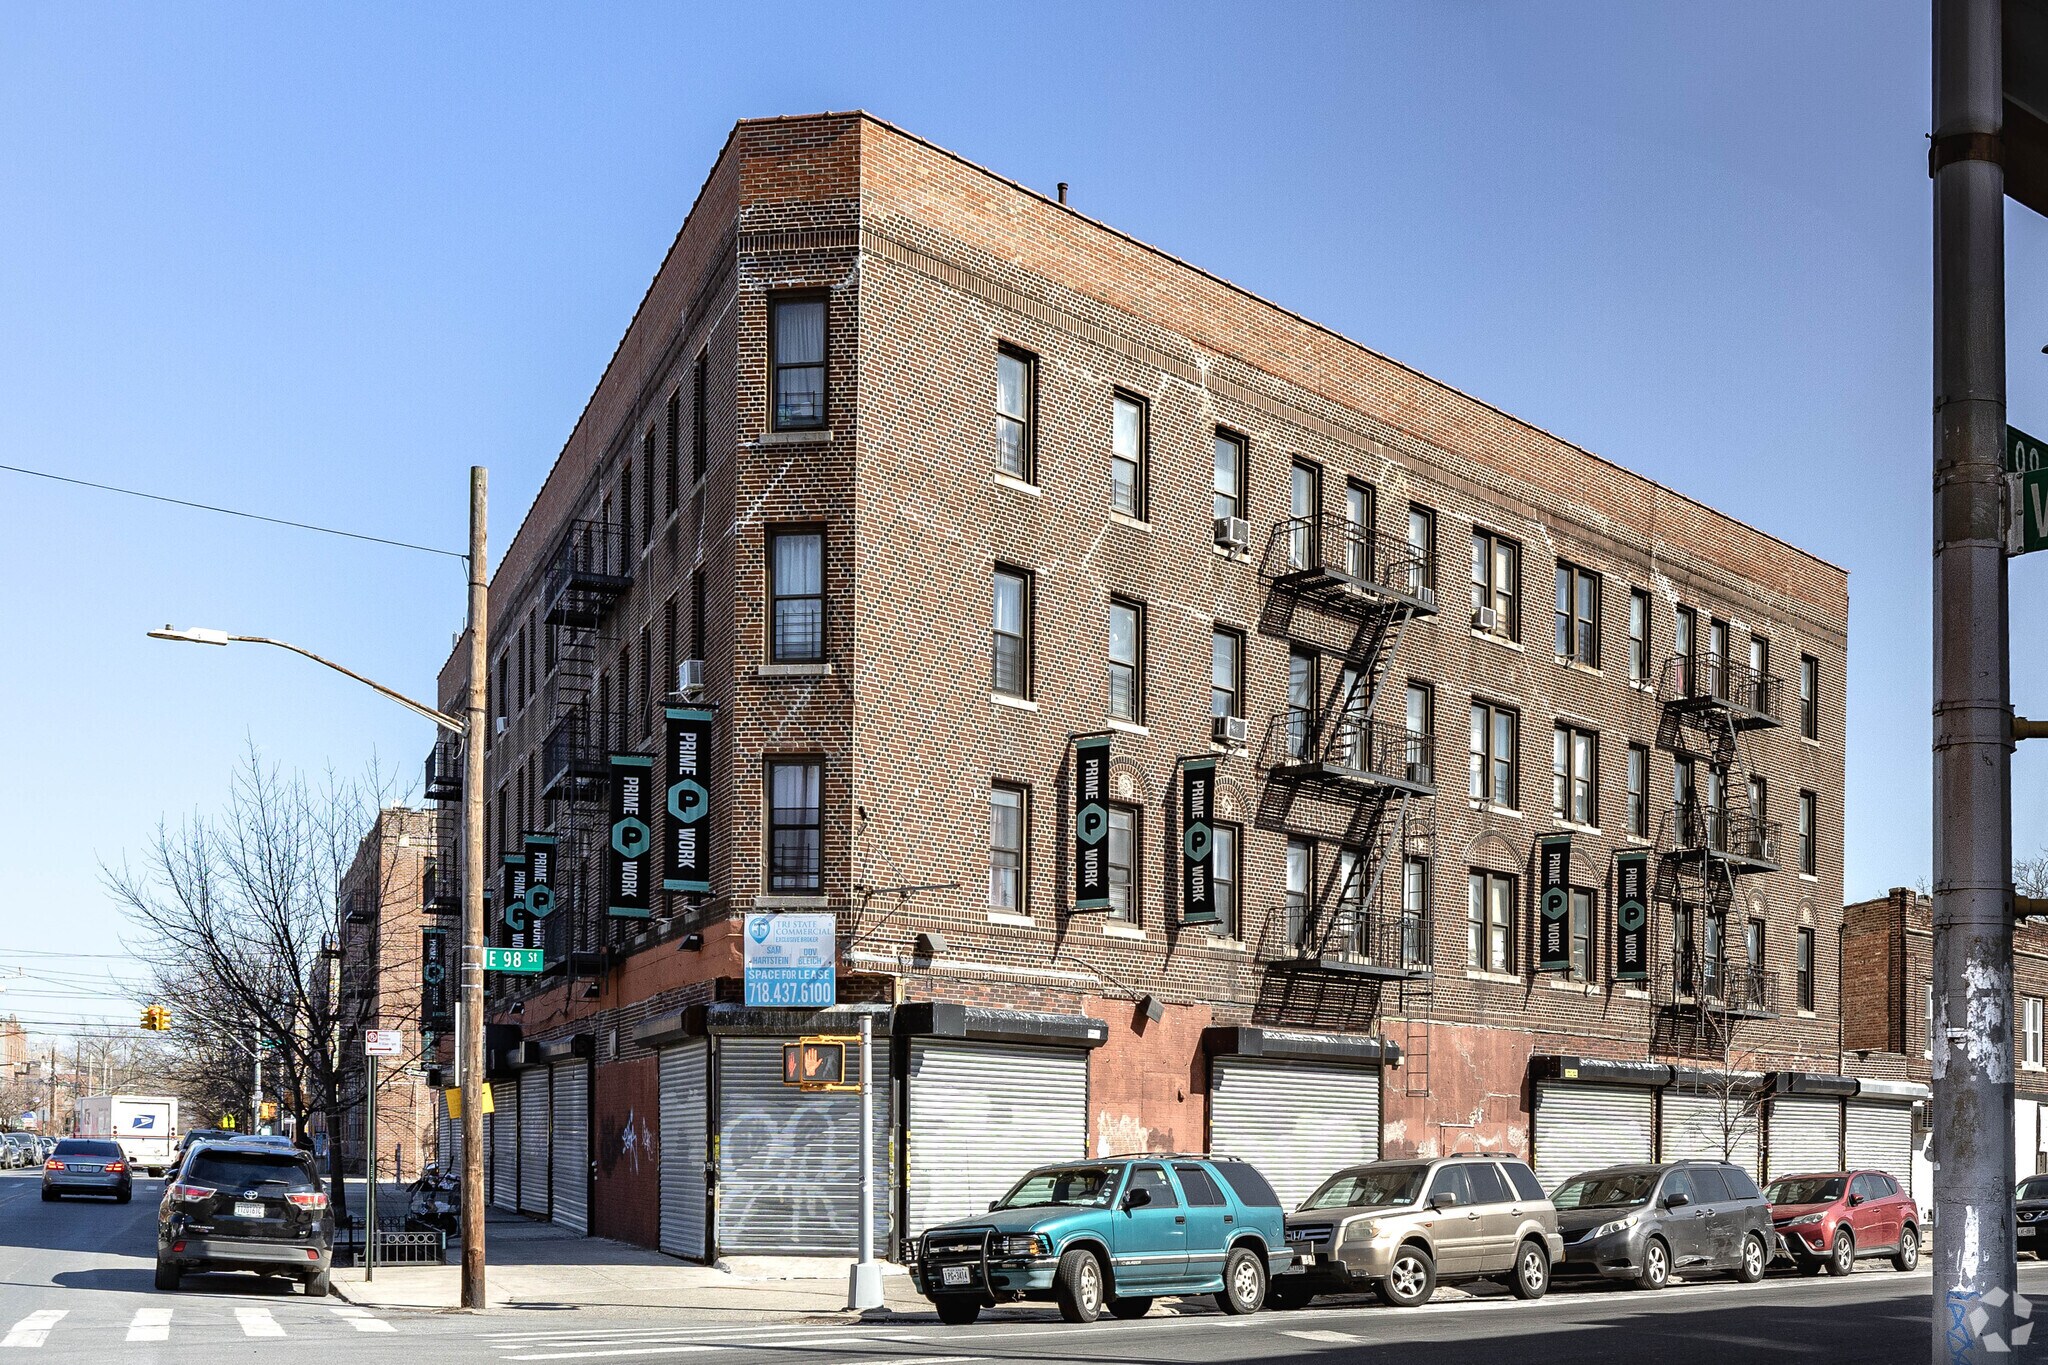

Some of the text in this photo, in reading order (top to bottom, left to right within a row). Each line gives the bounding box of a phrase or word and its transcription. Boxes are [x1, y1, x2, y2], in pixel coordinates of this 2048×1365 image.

[679, 732, 697, 776] PRIME
[1085, 759, 1099, 799] PRIME
[623, 776, 639, 815] PRIME
[1191, 779, 1205, 819] PRIME
[677, 828, 696, 869] WORK
[534, 852, 547, 883] PRIME
[621, 861, 638, 898] WORK
[1084, 848, 1098, 888] WORK
[1548, 853, 1561, 884] PRIME
[1625, 867, 1637, 898] PRIME
[513, 870, 526, 900] PRIME
[1191, 865, 1205, 903] WORK
[512, 933, 525, 948] WO
[776, 928, 831, 936] COMMERCIAL
[1548, 922, 1560, 953] WORK
[489, 951, 538, 968] E 98 St
[752, 956, 789, 965] HARTSTEIN
[766, 946, 782, 954] SAM
[1625, 934, 1637, 963] WORK
[748, 969, 830, 980] SPACE FOR LEASE
[748, 982, 831, 1003] 718.437.6100
